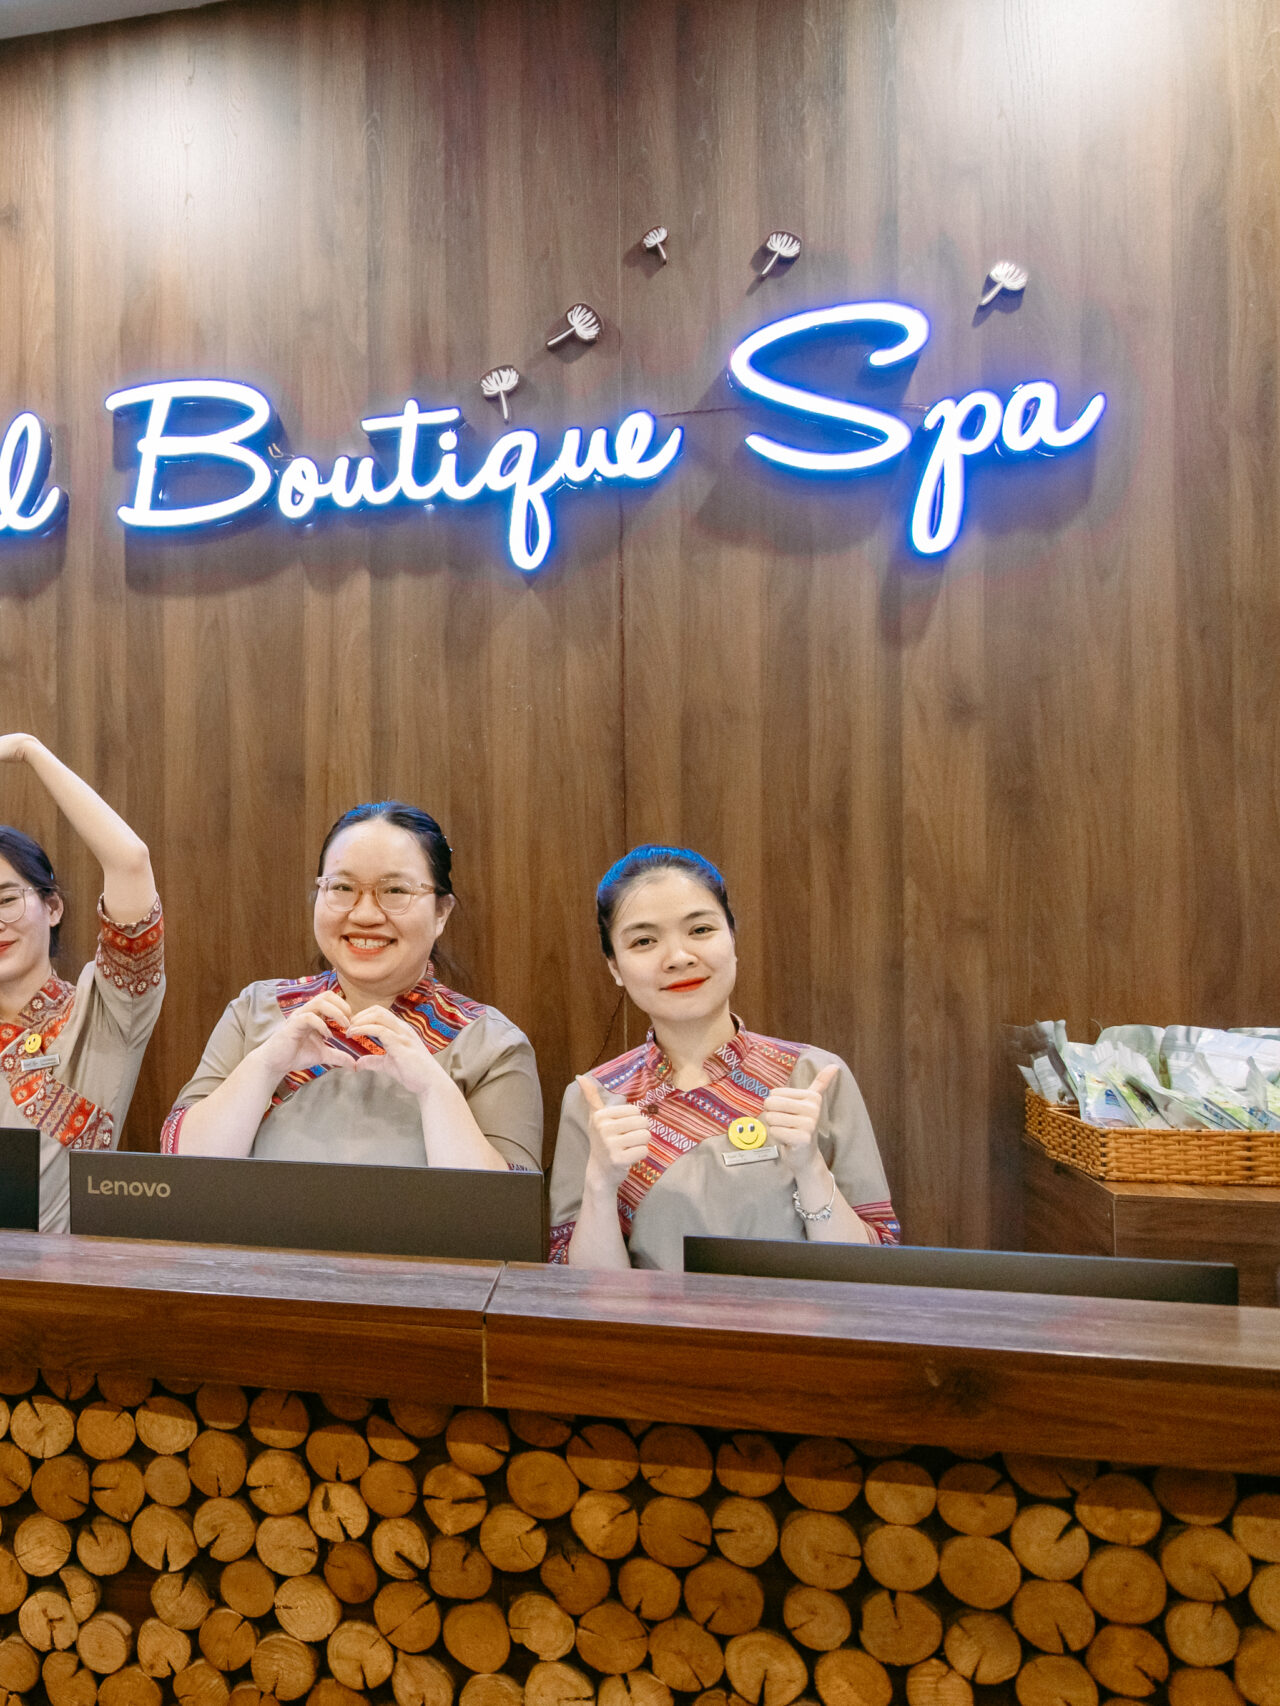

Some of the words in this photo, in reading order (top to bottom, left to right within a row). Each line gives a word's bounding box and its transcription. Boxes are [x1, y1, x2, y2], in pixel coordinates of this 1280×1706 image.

[104, 379, 683, 571] Boutique
[729, 302, 1105, 554] Spa
[87, 1175, 171, 1198] Lenovo
